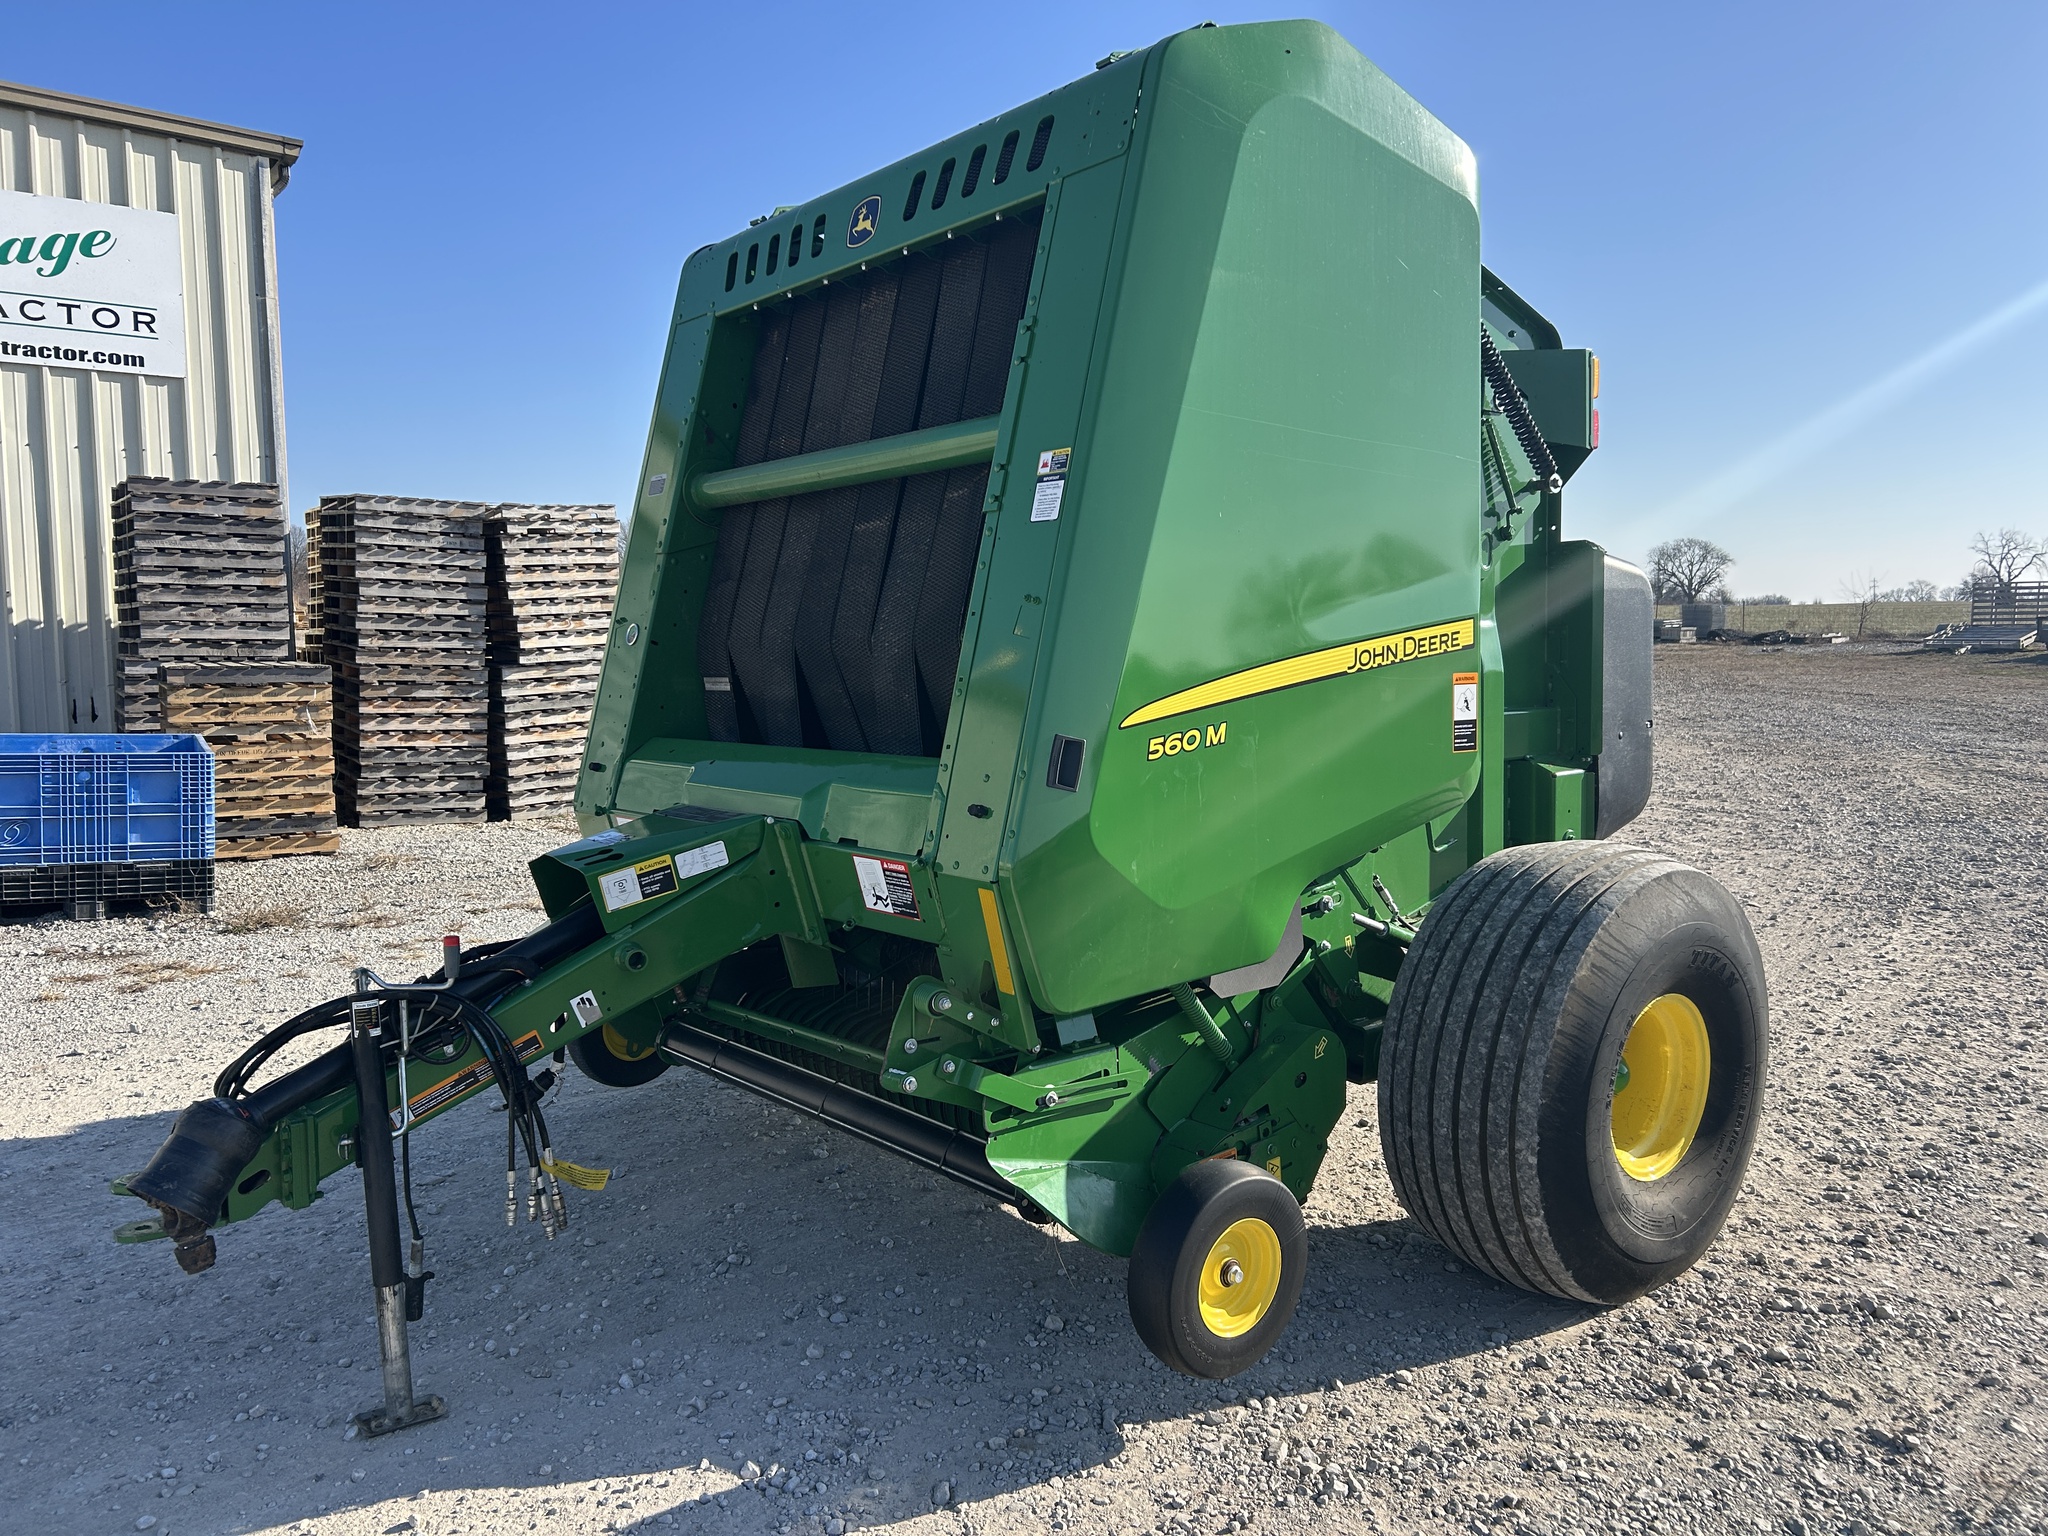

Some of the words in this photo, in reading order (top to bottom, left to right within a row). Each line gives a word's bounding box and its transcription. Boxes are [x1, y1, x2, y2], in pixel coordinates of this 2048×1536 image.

[0, 230, 117, 277] age
[1, 341, 145, 367] tractor.com
[1347, 643, 1399, 671] JOHN
[1403, 630, 1461, 653] DEERE
[1147, 730, 1202, 761] 560
[1205, 722, 1228, 748] M
[644, 859, 667, 870] CAUTION
[887, 863, 906, 871] DANGER
[1687, 949, 1740, 989] TITAN
